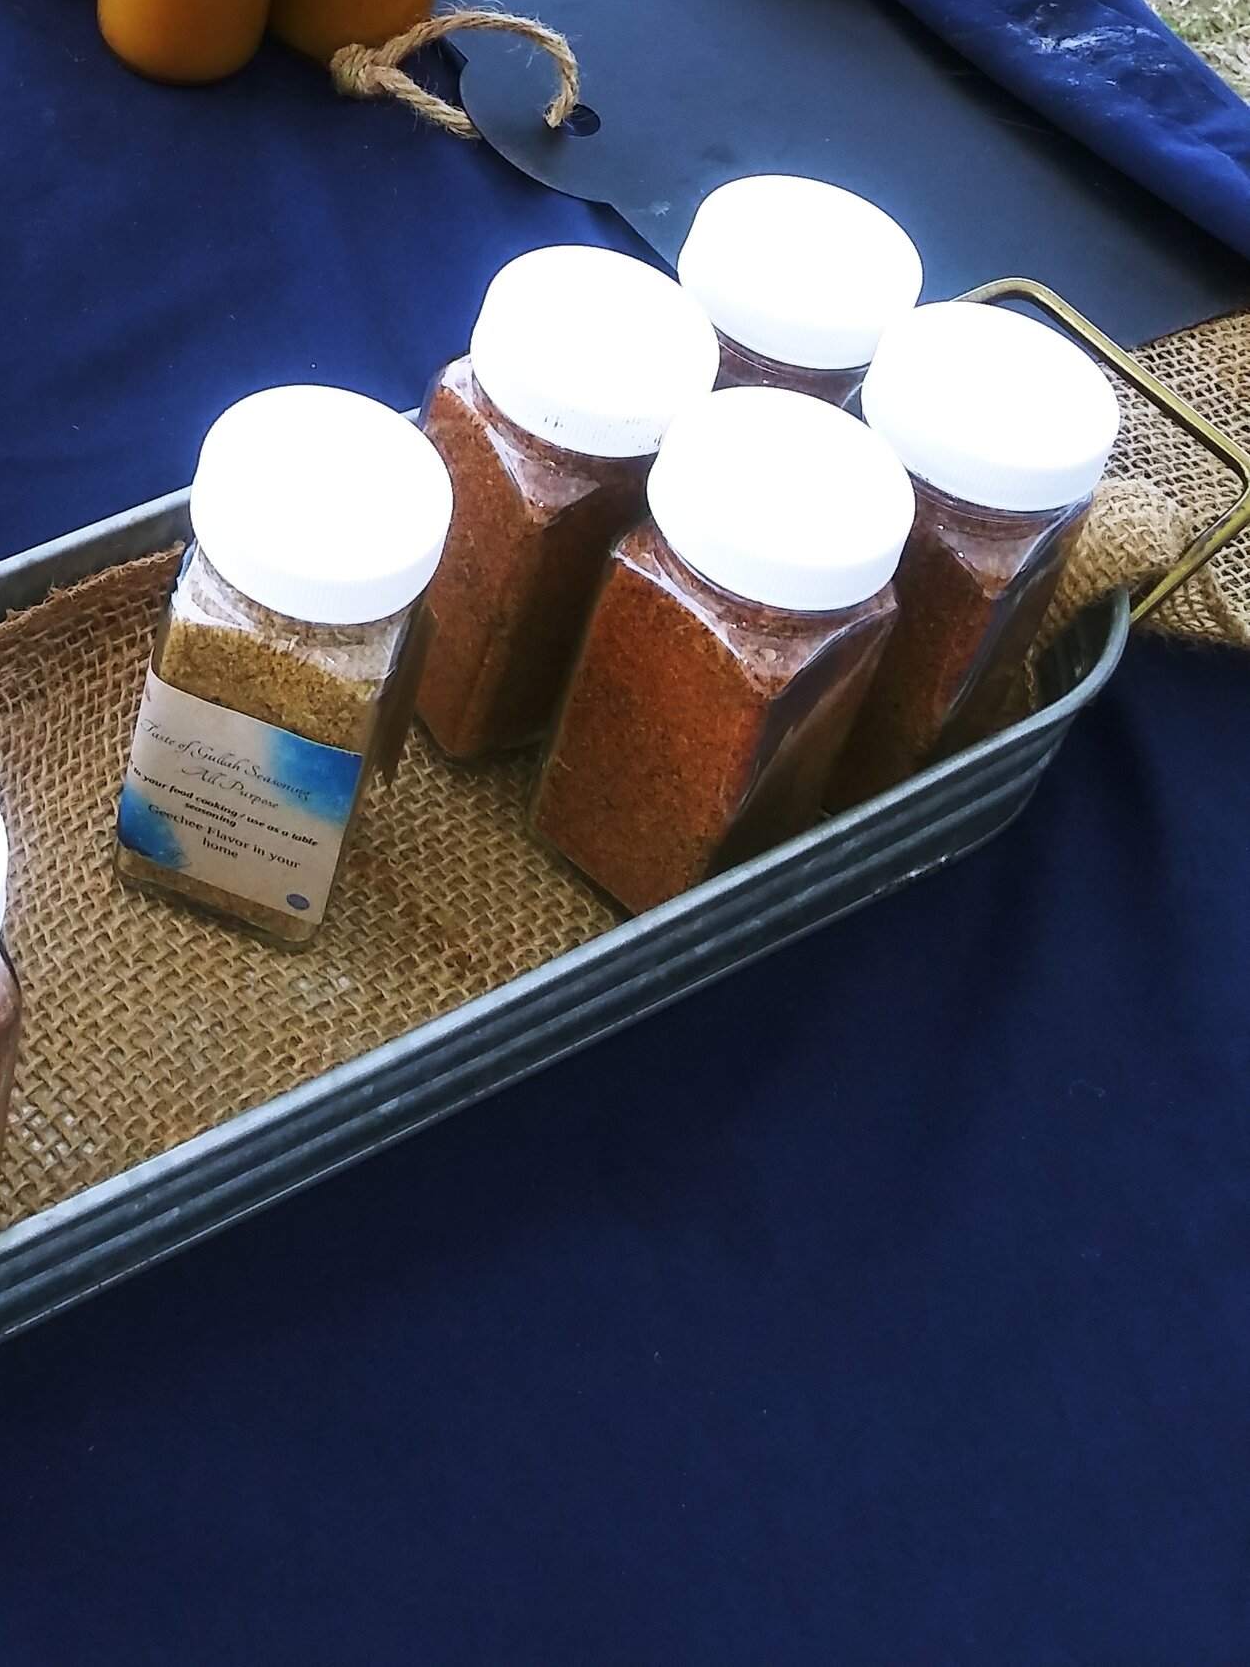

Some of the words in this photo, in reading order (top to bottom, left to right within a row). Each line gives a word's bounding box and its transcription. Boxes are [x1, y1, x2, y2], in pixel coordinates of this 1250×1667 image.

[141, 718, 176, 745] Taste
[175, 740, 201, 753] of
[190, 746, 249, 771] Gullah
[244, 765, 311, 801] Seasoning
[143, 774, 168, 789] your
[169, 785, 195, 799] food
[195, 795, 239, 817] cooking
[246, 816, 266, 827] use
[267, 825, 279, 834] as
[291, 833, 319, 847] table
[181, 767, 227, 785] All
[219, 780, 279, 808] Purpose
[148, 804, 203, 830] Geechee
[207, 826, 250, 849] Flavor
[253, 844, 266, 856] in
[268, 852, 301, 869] your
[184, 802, 237, 828] seasoning
[202, 837, 239, 859] home
